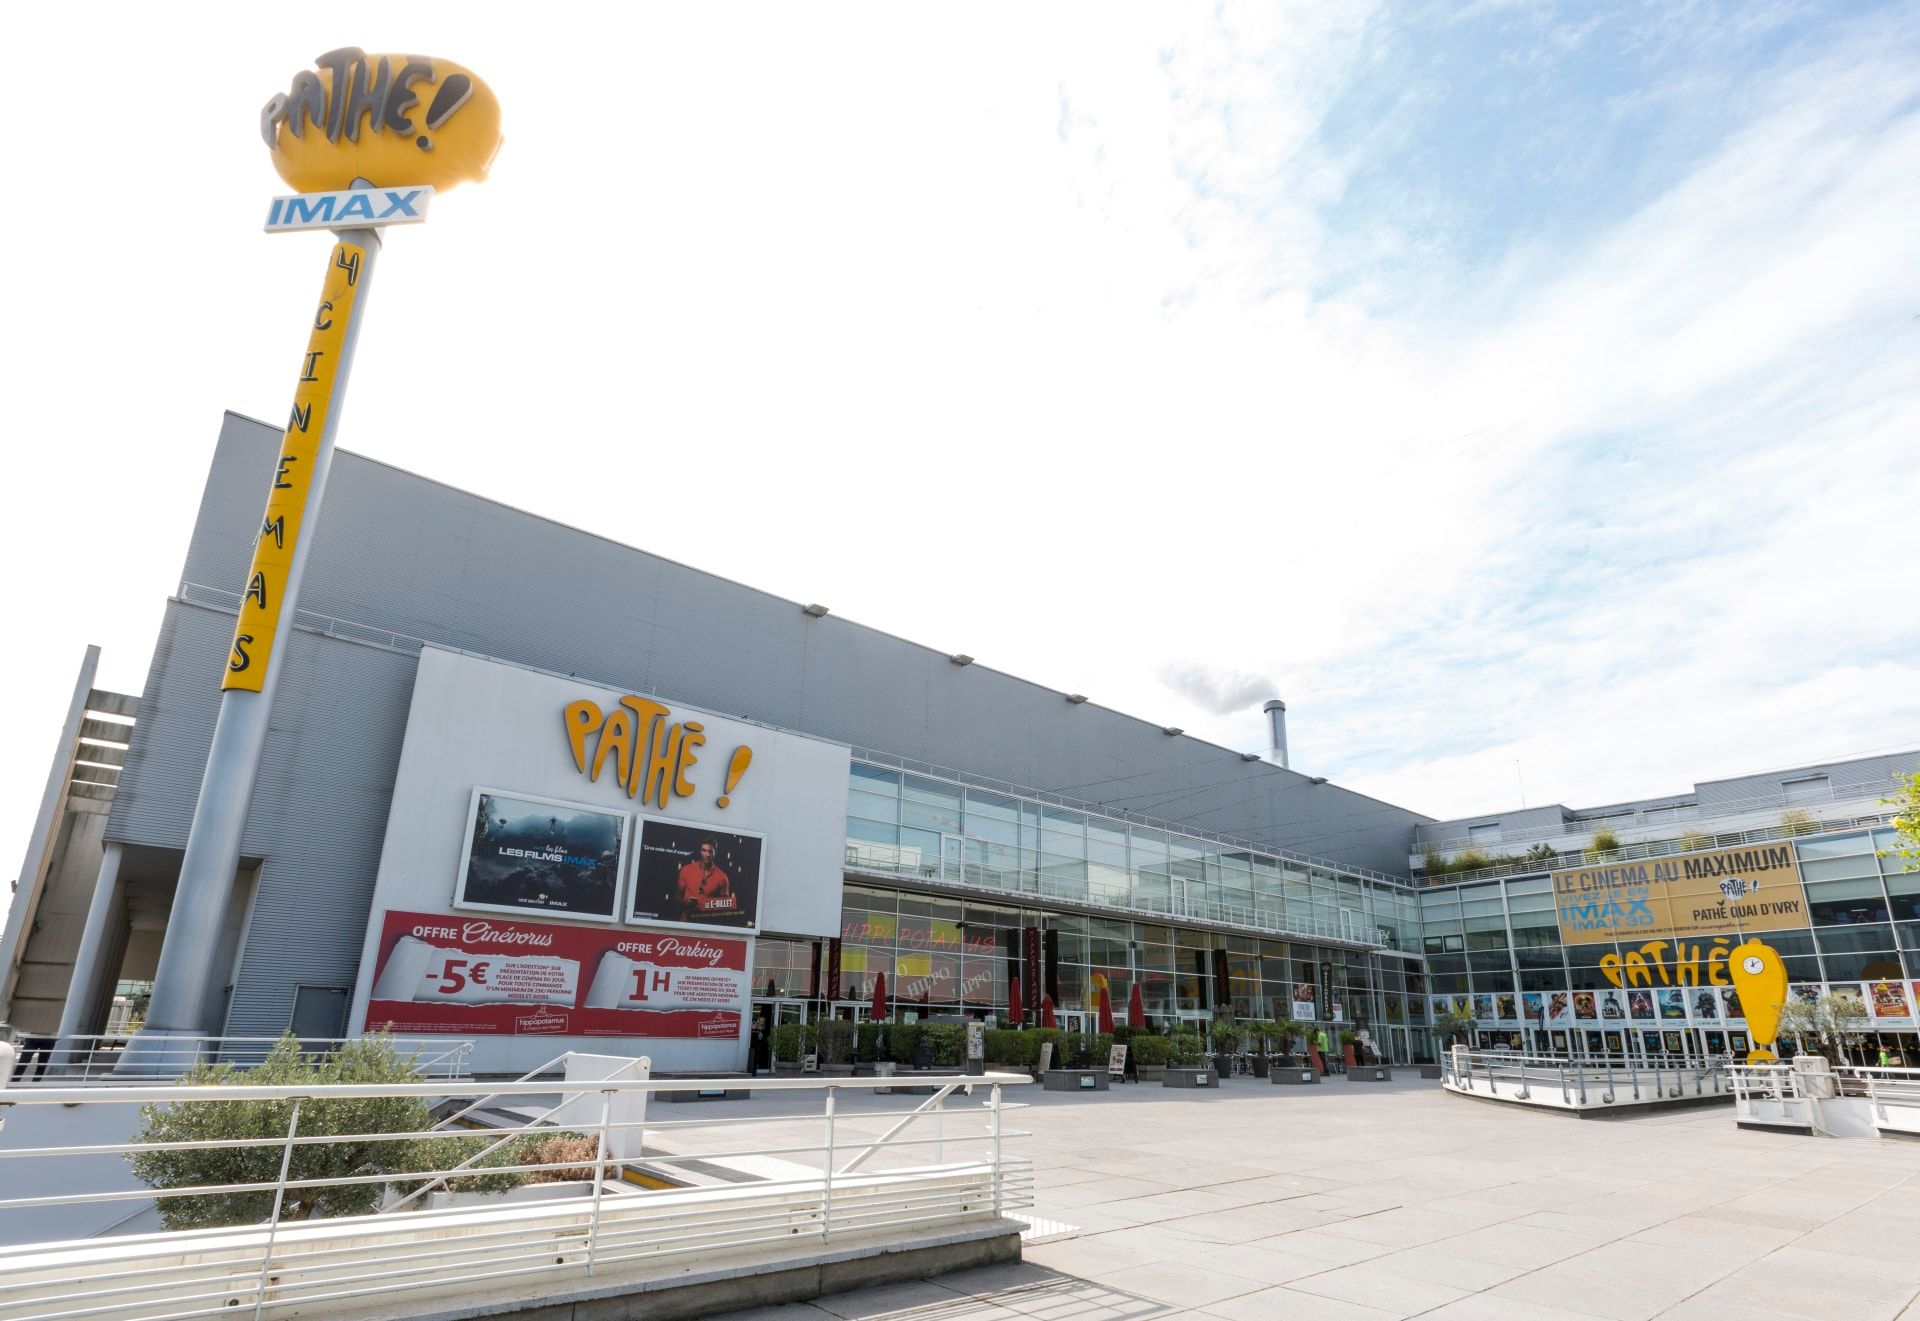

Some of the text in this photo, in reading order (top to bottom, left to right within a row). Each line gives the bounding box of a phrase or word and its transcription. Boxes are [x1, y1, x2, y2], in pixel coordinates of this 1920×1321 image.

[268, 190, 424, 226] IMAX
[229, 247, 359, 672] 4 CINEMAS
[499, 847, 598, 867] LES FILMS IMAX
[1555, 846, 1791, 895] LE CINEMA AU MAXIMUM
[1627, 887, 1649, 897] EN
[1561, 897, 1654, 923] IMAX
[1572, 918, 1619, 932] IMAX
[1625, 913, 1655, 927] 3D
[1730, 904, 1758, 919] QUAI
[1760, 901, 1800, 916] D'IVRY
[412, 921, 553, 946] OFFRE Cinévorus
[617, 938, 724, 966] OFFRE Parking
[426, 959, 490, 994] -5€
[519, 1017, 565, 1026] hippopotamus
[701, 1022, 737, 1030] hippopotamus
